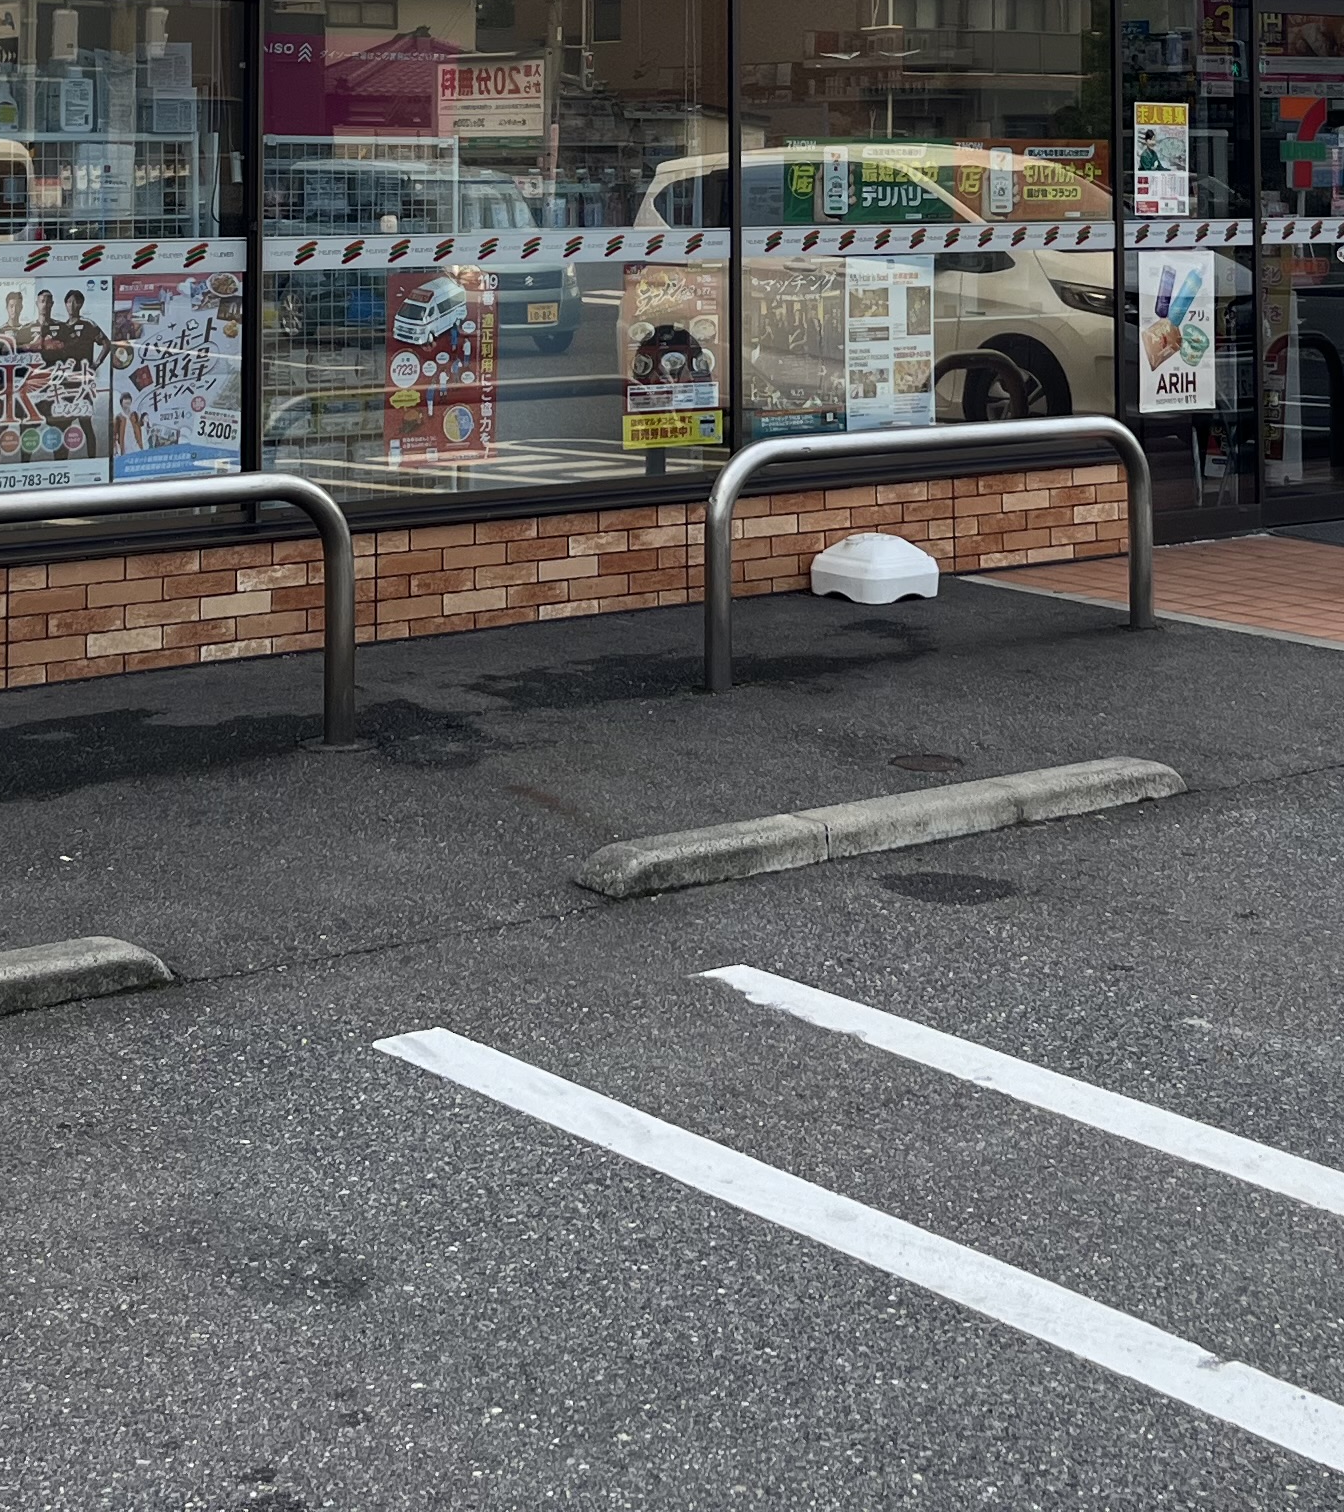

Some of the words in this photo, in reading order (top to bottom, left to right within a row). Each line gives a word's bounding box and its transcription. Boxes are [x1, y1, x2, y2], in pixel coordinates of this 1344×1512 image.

[1137, 105, 1187, 125] 求人募集
[862, 185, 940, 208] デリバリー
[141, 317, 218, 364] パスポート
[153, 346, 211, 389] 取得
[148, 377, 217, 412] キャンペーン
[1156, 372, 1197, 395] ARIH
